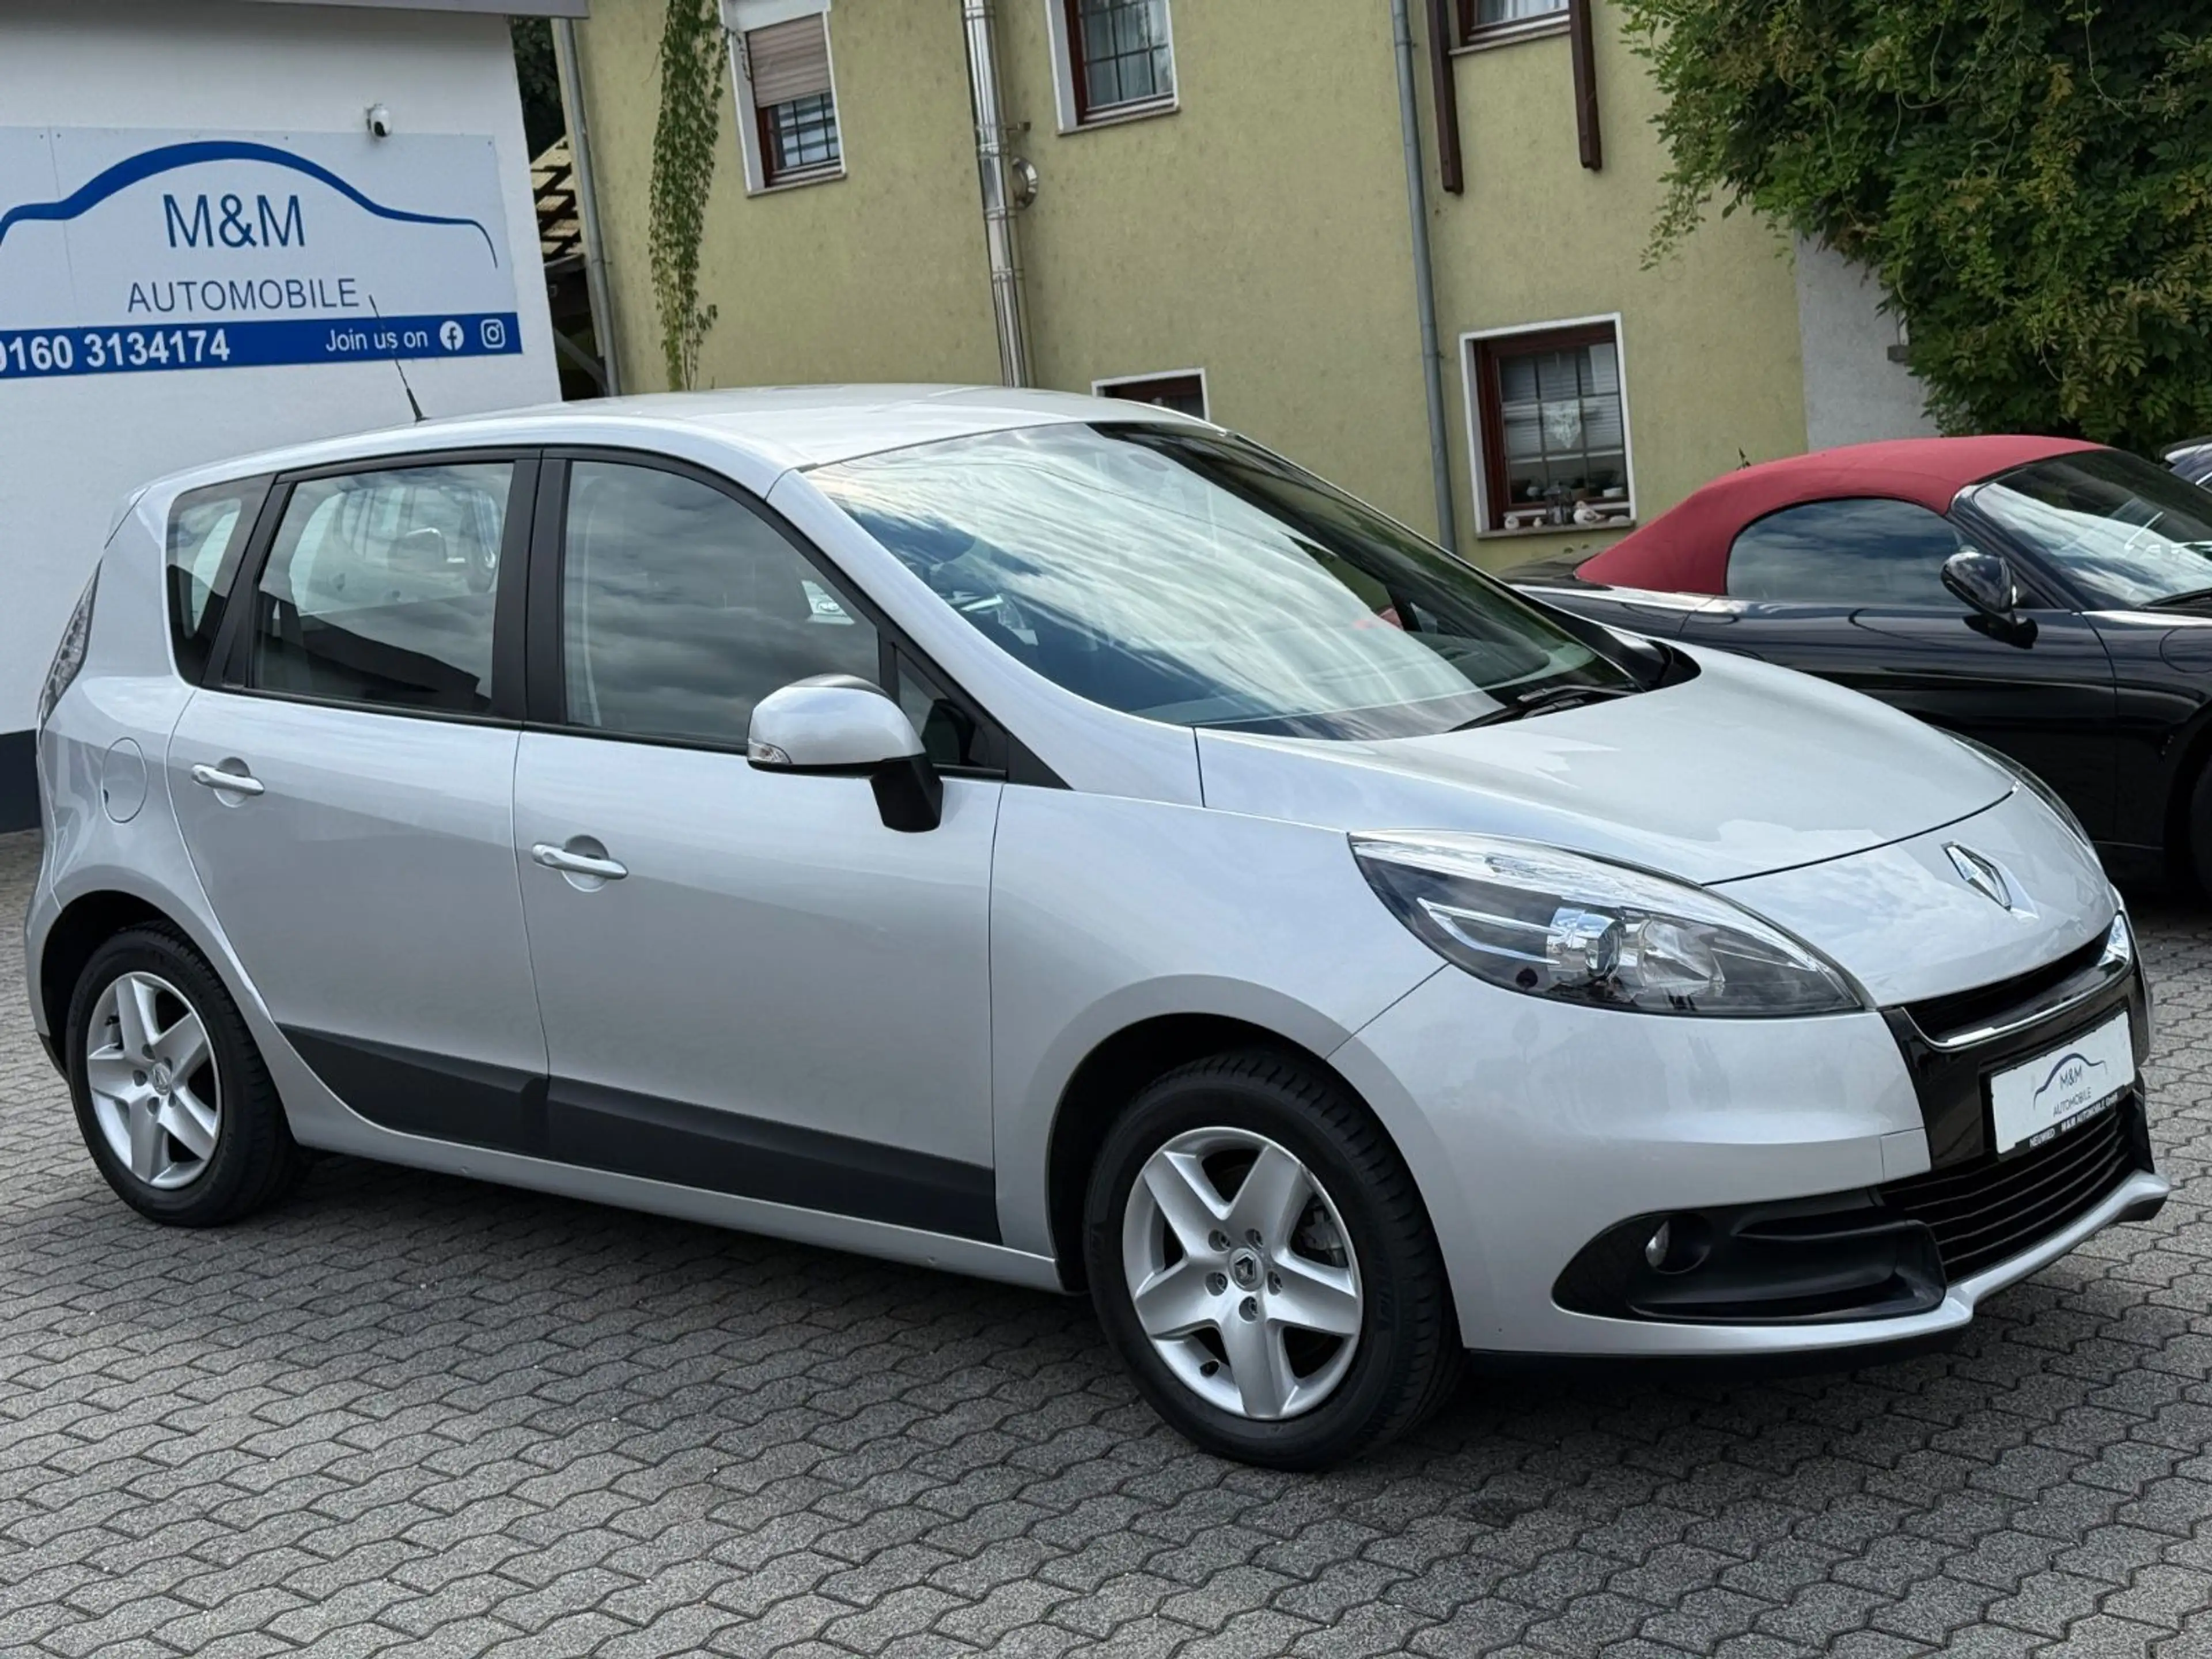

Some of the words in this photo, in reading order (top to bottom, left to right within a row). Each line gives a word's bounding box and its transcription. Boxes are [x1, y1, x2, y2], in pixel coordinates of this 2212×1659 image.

[163, 194, 305, 248] M&M
[127, 278, 359, 313] AUTOMOBILE
[84, 328, 230, 368] 3134174
[325, 328, 368, 352] Join
[374, 331, 398, 350] us
[404, 330, 428, 349] on
[2059, 1065, 2082, 1090] M&M
[2053, 1086, 2092, 1118] AUTOMOBILE
